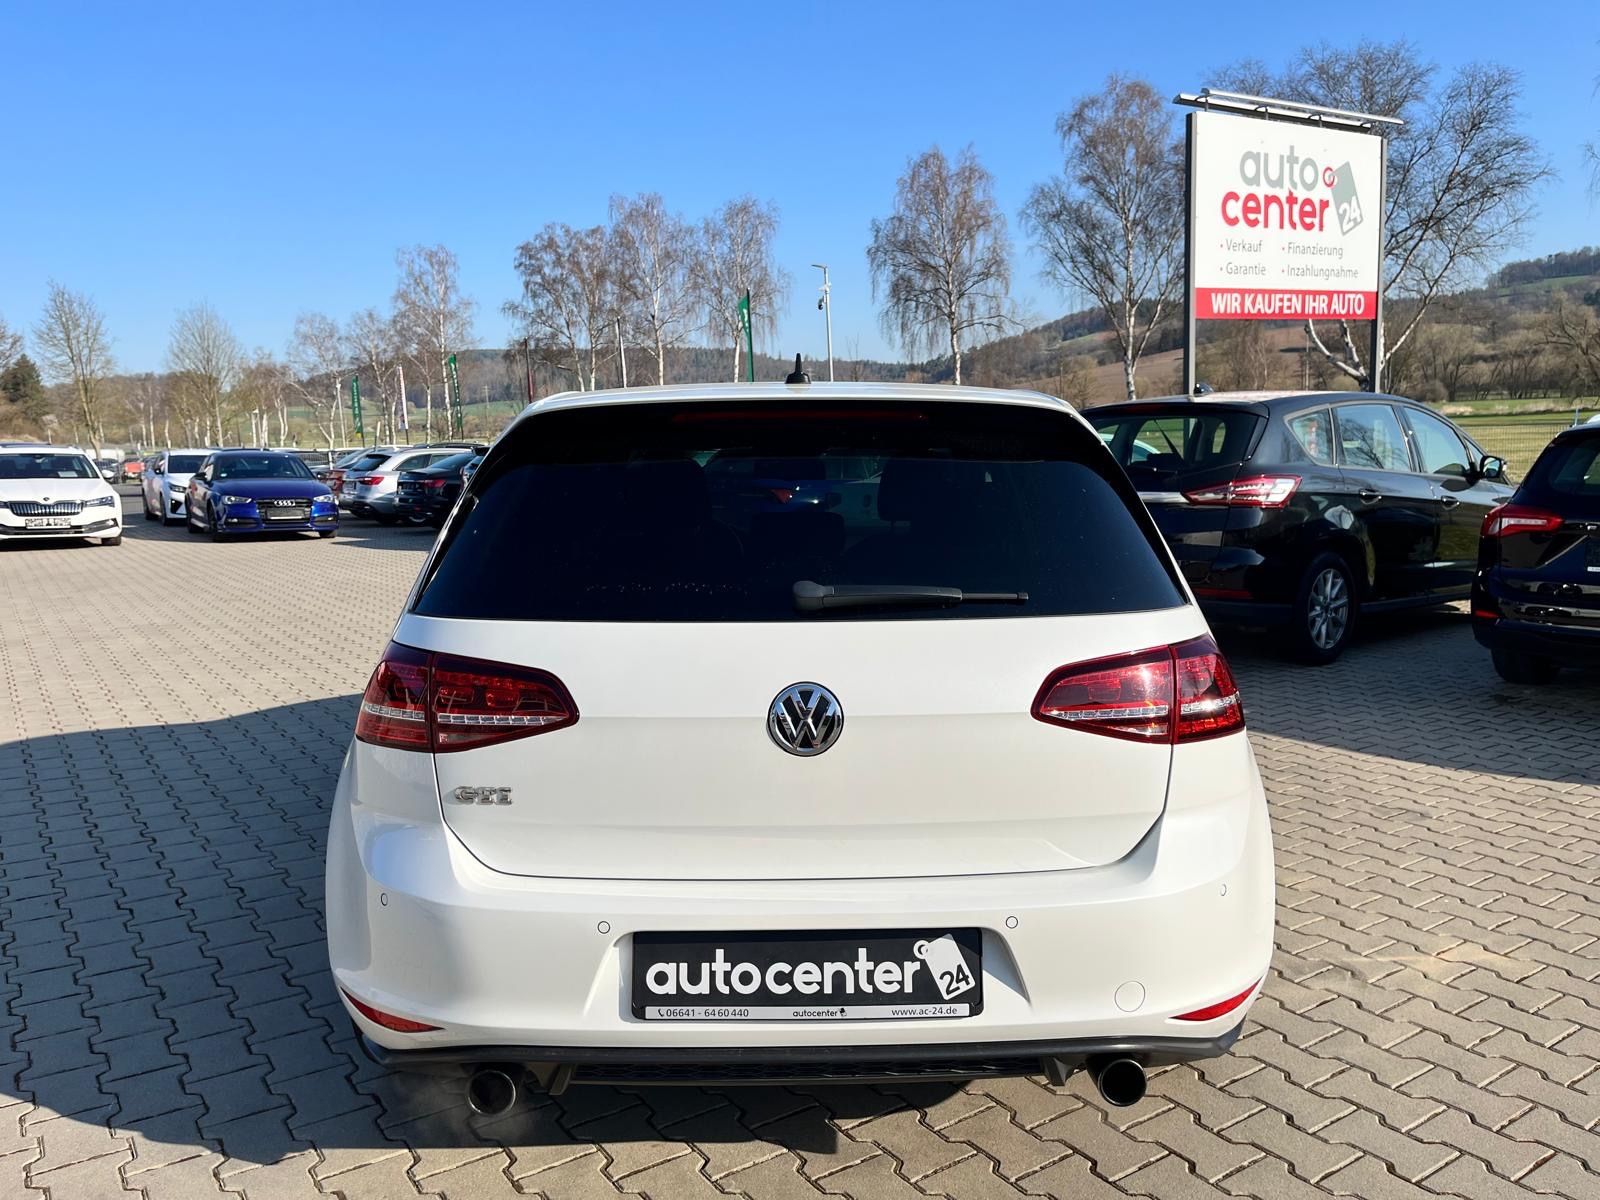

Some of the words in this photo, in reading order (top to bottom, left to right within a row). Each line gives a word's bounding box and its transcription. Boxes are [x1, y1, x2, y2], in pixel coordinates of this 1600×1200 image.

[1240, 145, 1319, 191] auto
[1221, 188, 1330, 232] center
[1339, 198, 1362, 229] 24
[1225, 239, 1263, 253] Verkauf
[1287, 242, 1344, 260] Finanzierung
[1225, 262, 1267, 276] Garantie
[1287, 264, 1359, 280] Inzahlungnahme
[1211, 292, 1241, 314] WIR
[1244, 293, 1302, 315] KAUFEN
[1304, 294, 1329, 315] IHR
[1330, 293, 1365, 315] AUTO
[455, 785, 513, 805] GTI
[939, 963, 971, 996] 24
[666, 1008, 696, 1017] 06641
[792, 1009, 838, 1018] autocenter
[891, 1006, 958, 1016] www.ac-24.de
